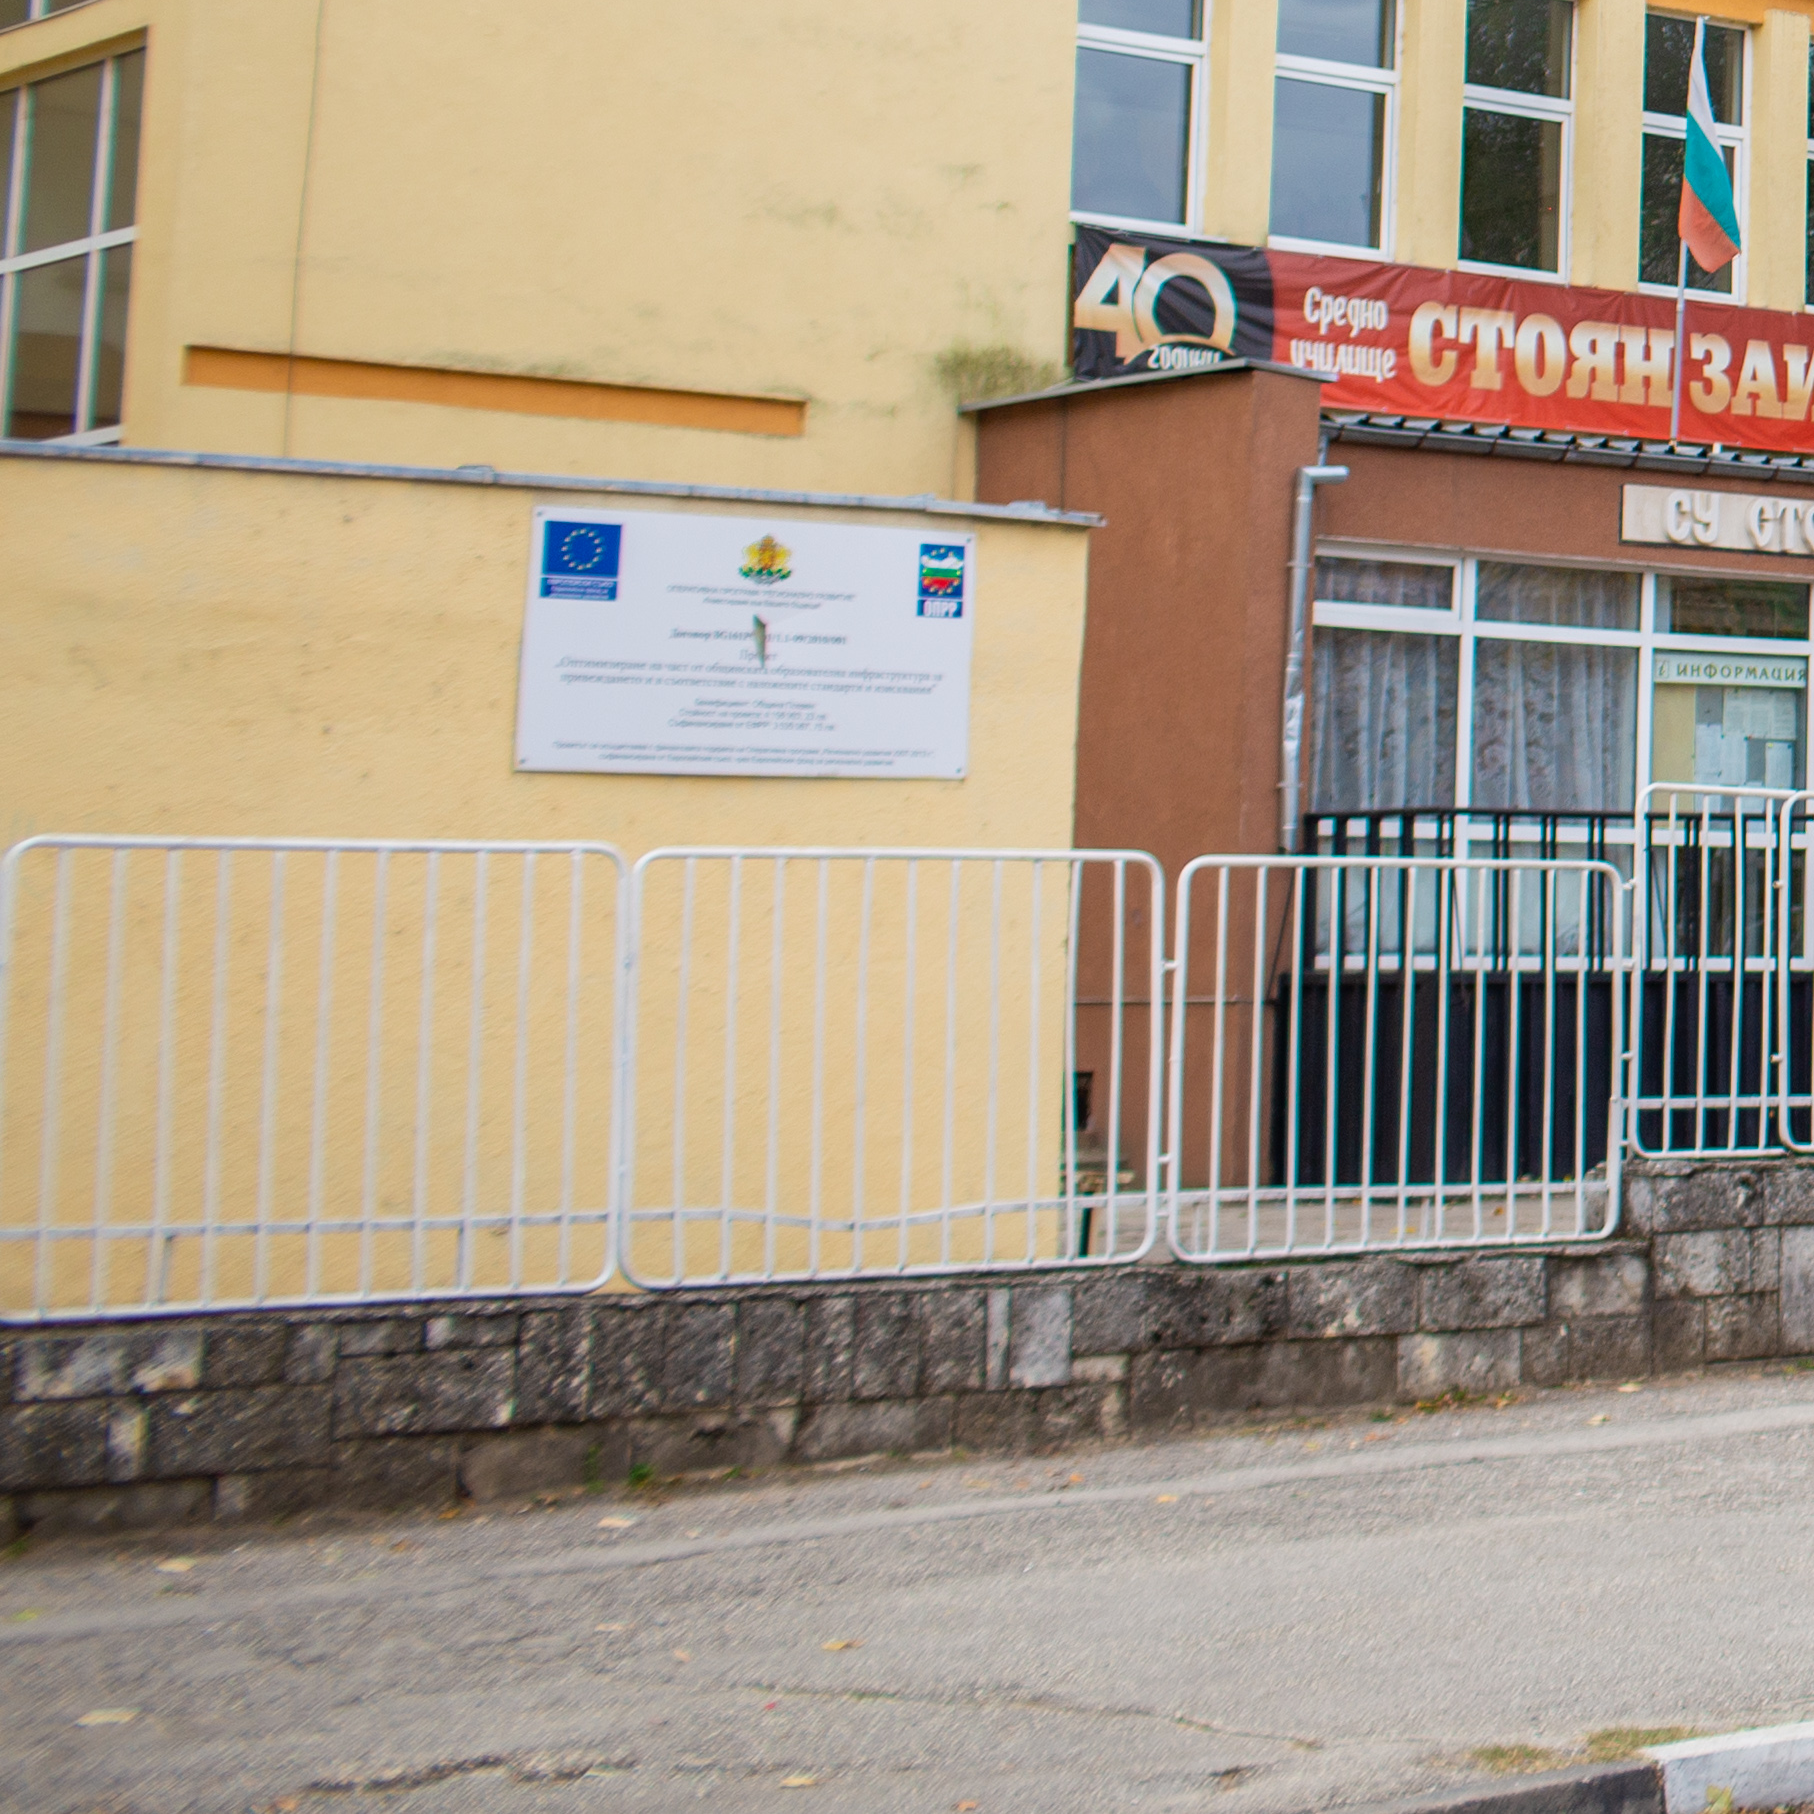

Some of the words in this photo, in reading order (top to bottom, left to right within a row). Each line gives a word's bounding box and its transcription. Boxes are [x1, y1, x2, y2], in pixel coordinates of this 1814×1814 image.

[1074, 243, 1236, 365] 40
[1303, 286, 1388, 337] Средно
[1290, 339, 1398, 381] училище
[1408, 300, 1676, 408] СТОЯН
[1666, 491, 1719, 542] СУ
[923, 599, 958, 617] ОПРР
[1677, 664, 1807, 682] ИНФОРМАЦИЯ
